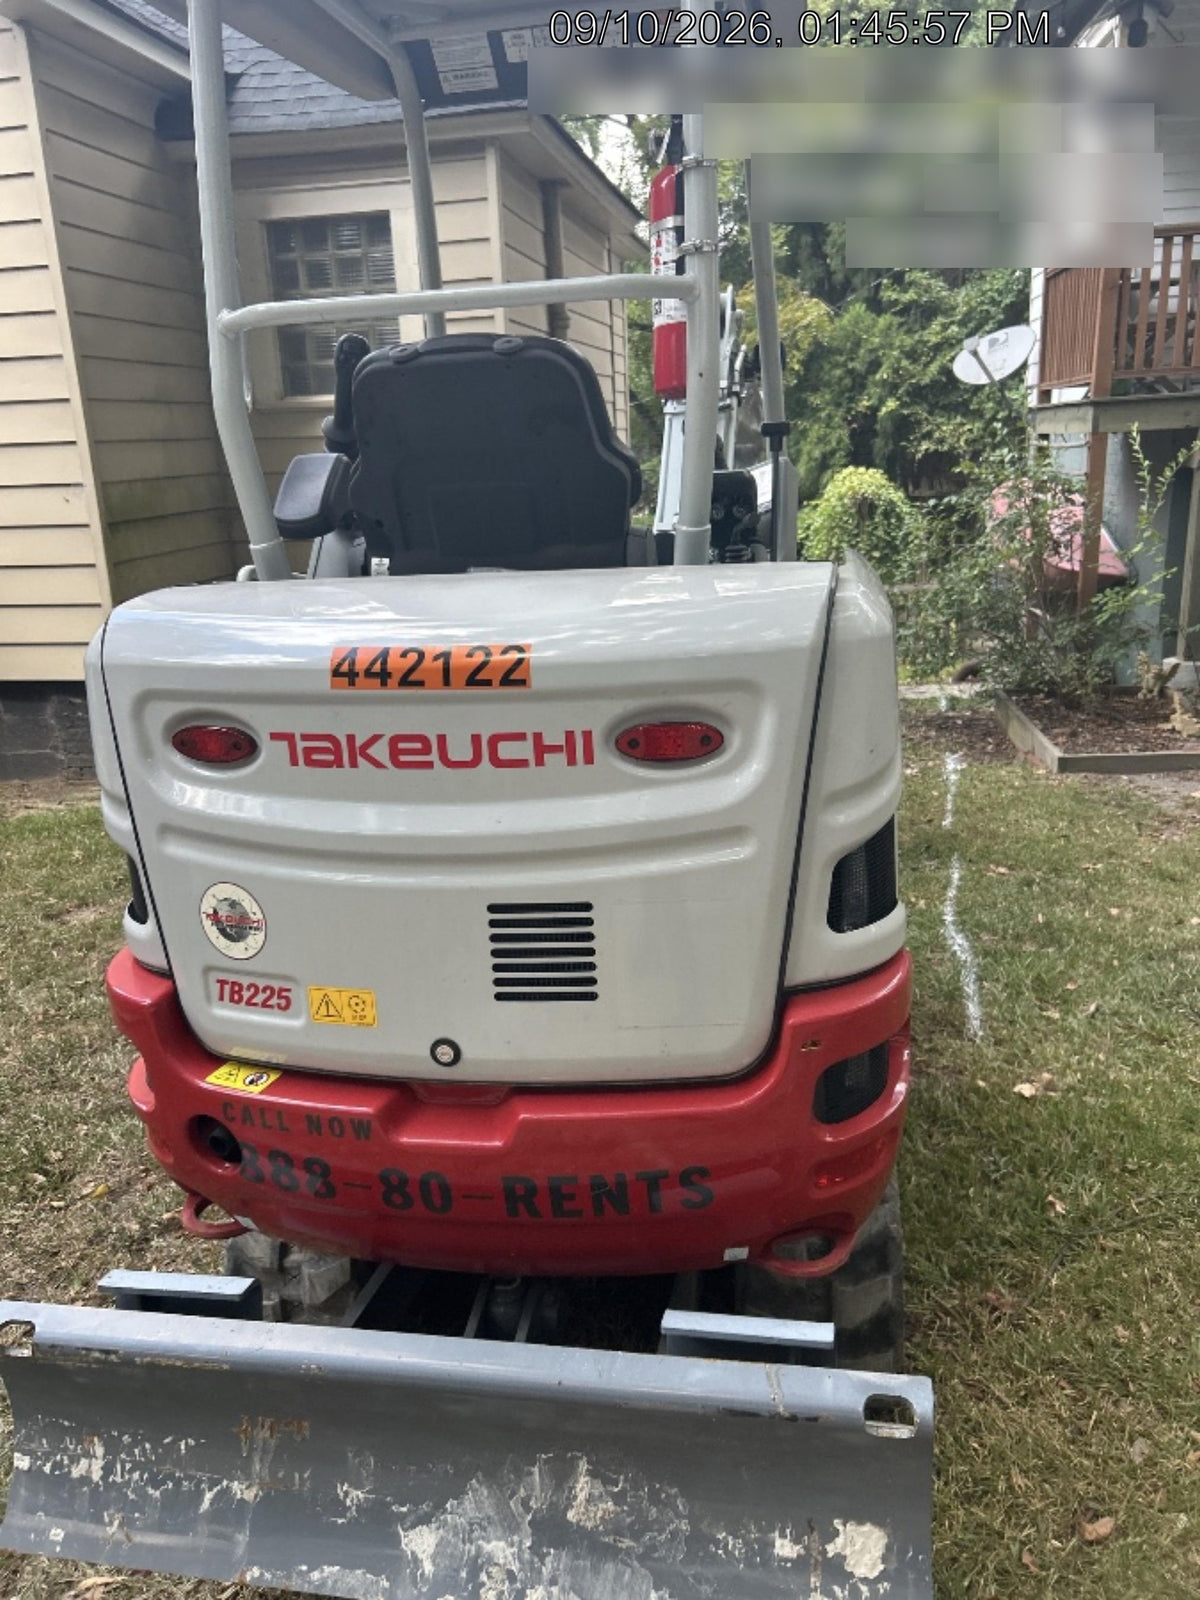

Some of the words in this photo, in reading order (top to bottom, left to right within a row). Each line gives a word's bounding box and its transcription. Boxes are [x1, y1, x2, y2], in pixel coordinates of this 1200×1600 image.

[331, 645, 528, 688] 442122
[216, 978, 292, 1012] TB225
[221, 1101, 291, 1133] CALL
[305, 1114, 373, 1141] NOW
